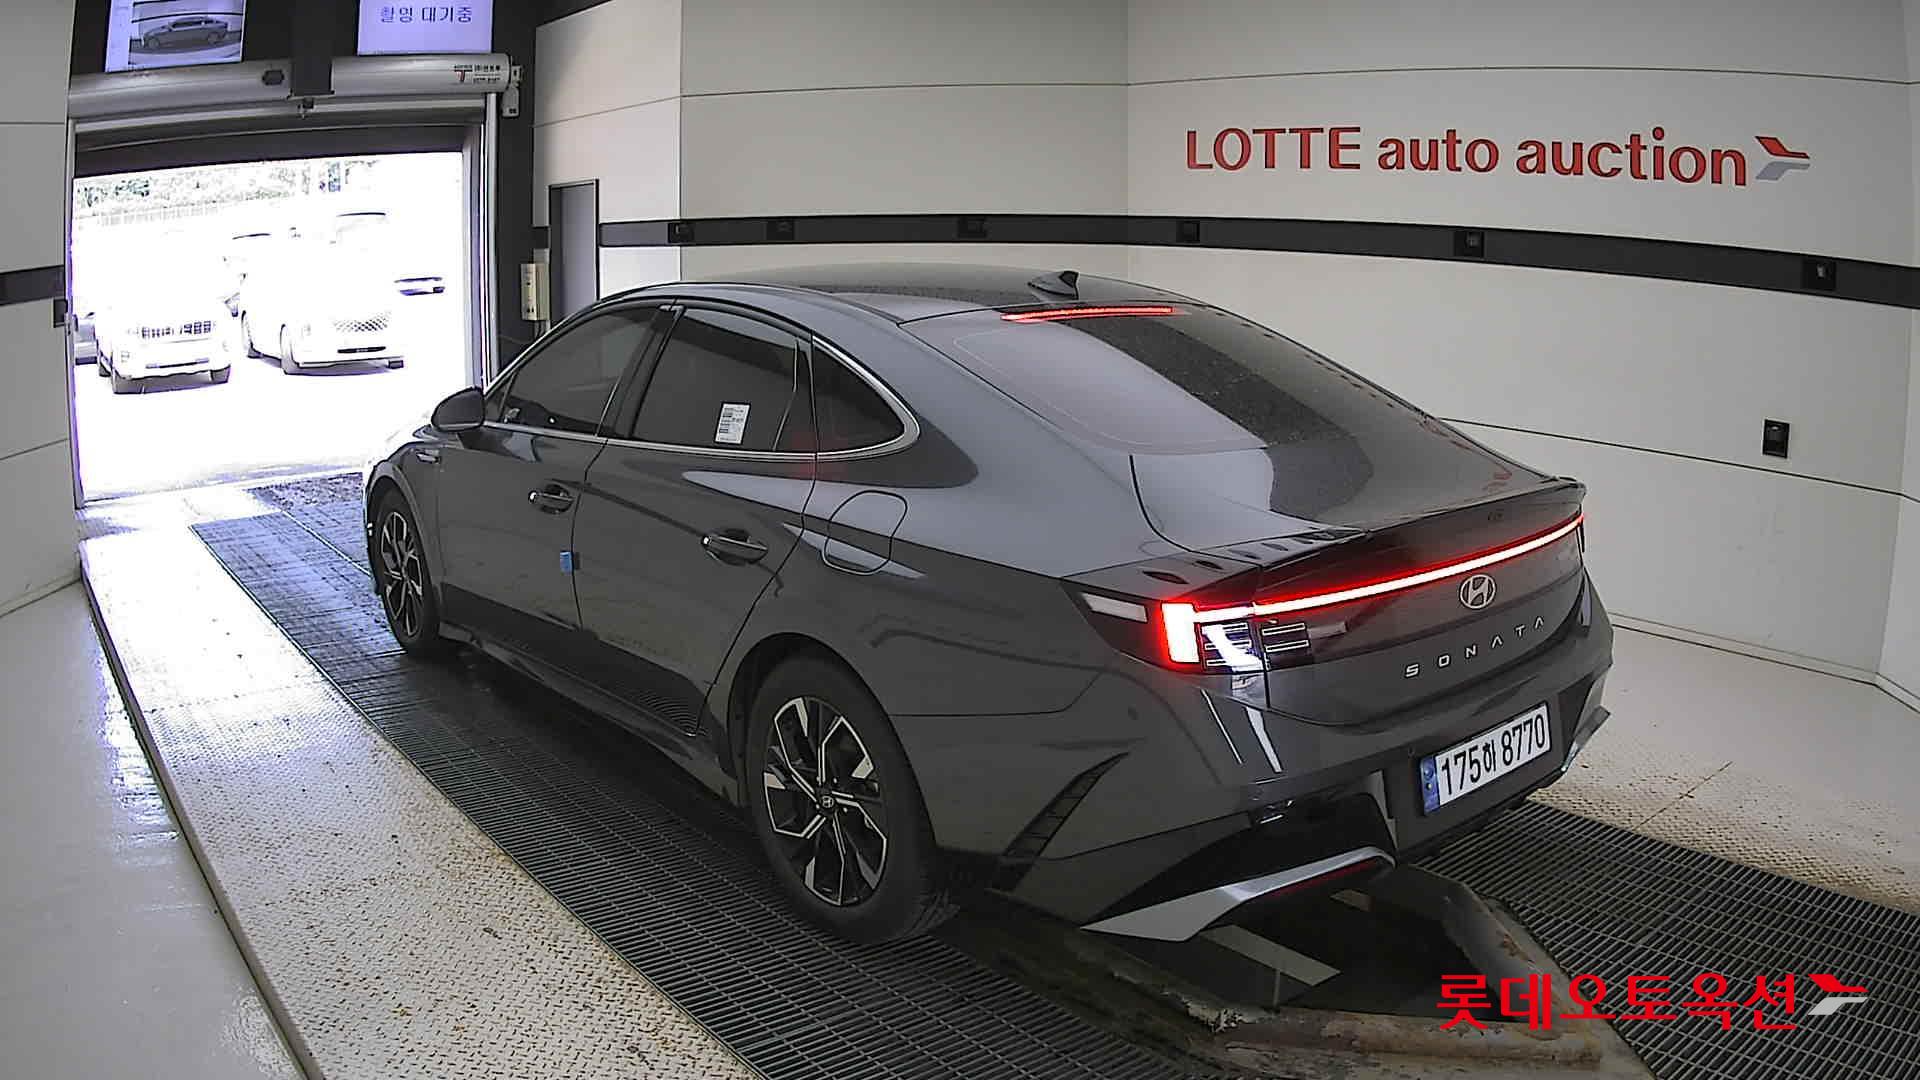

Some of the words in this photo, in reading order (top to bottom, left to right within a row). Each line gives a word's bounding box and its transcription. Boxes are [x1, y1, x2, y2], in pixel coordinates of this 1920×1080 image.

[421, 5, 473, 23] 대기중
[1186, 126, 1361, 171] LOTTE
[1377, 128, 1499, 173] auto
[1516, 126, 1747, 187] auction
[1404, 616, 1544, 678] SONATA
[1501, 713, 1546, 767] 8770
